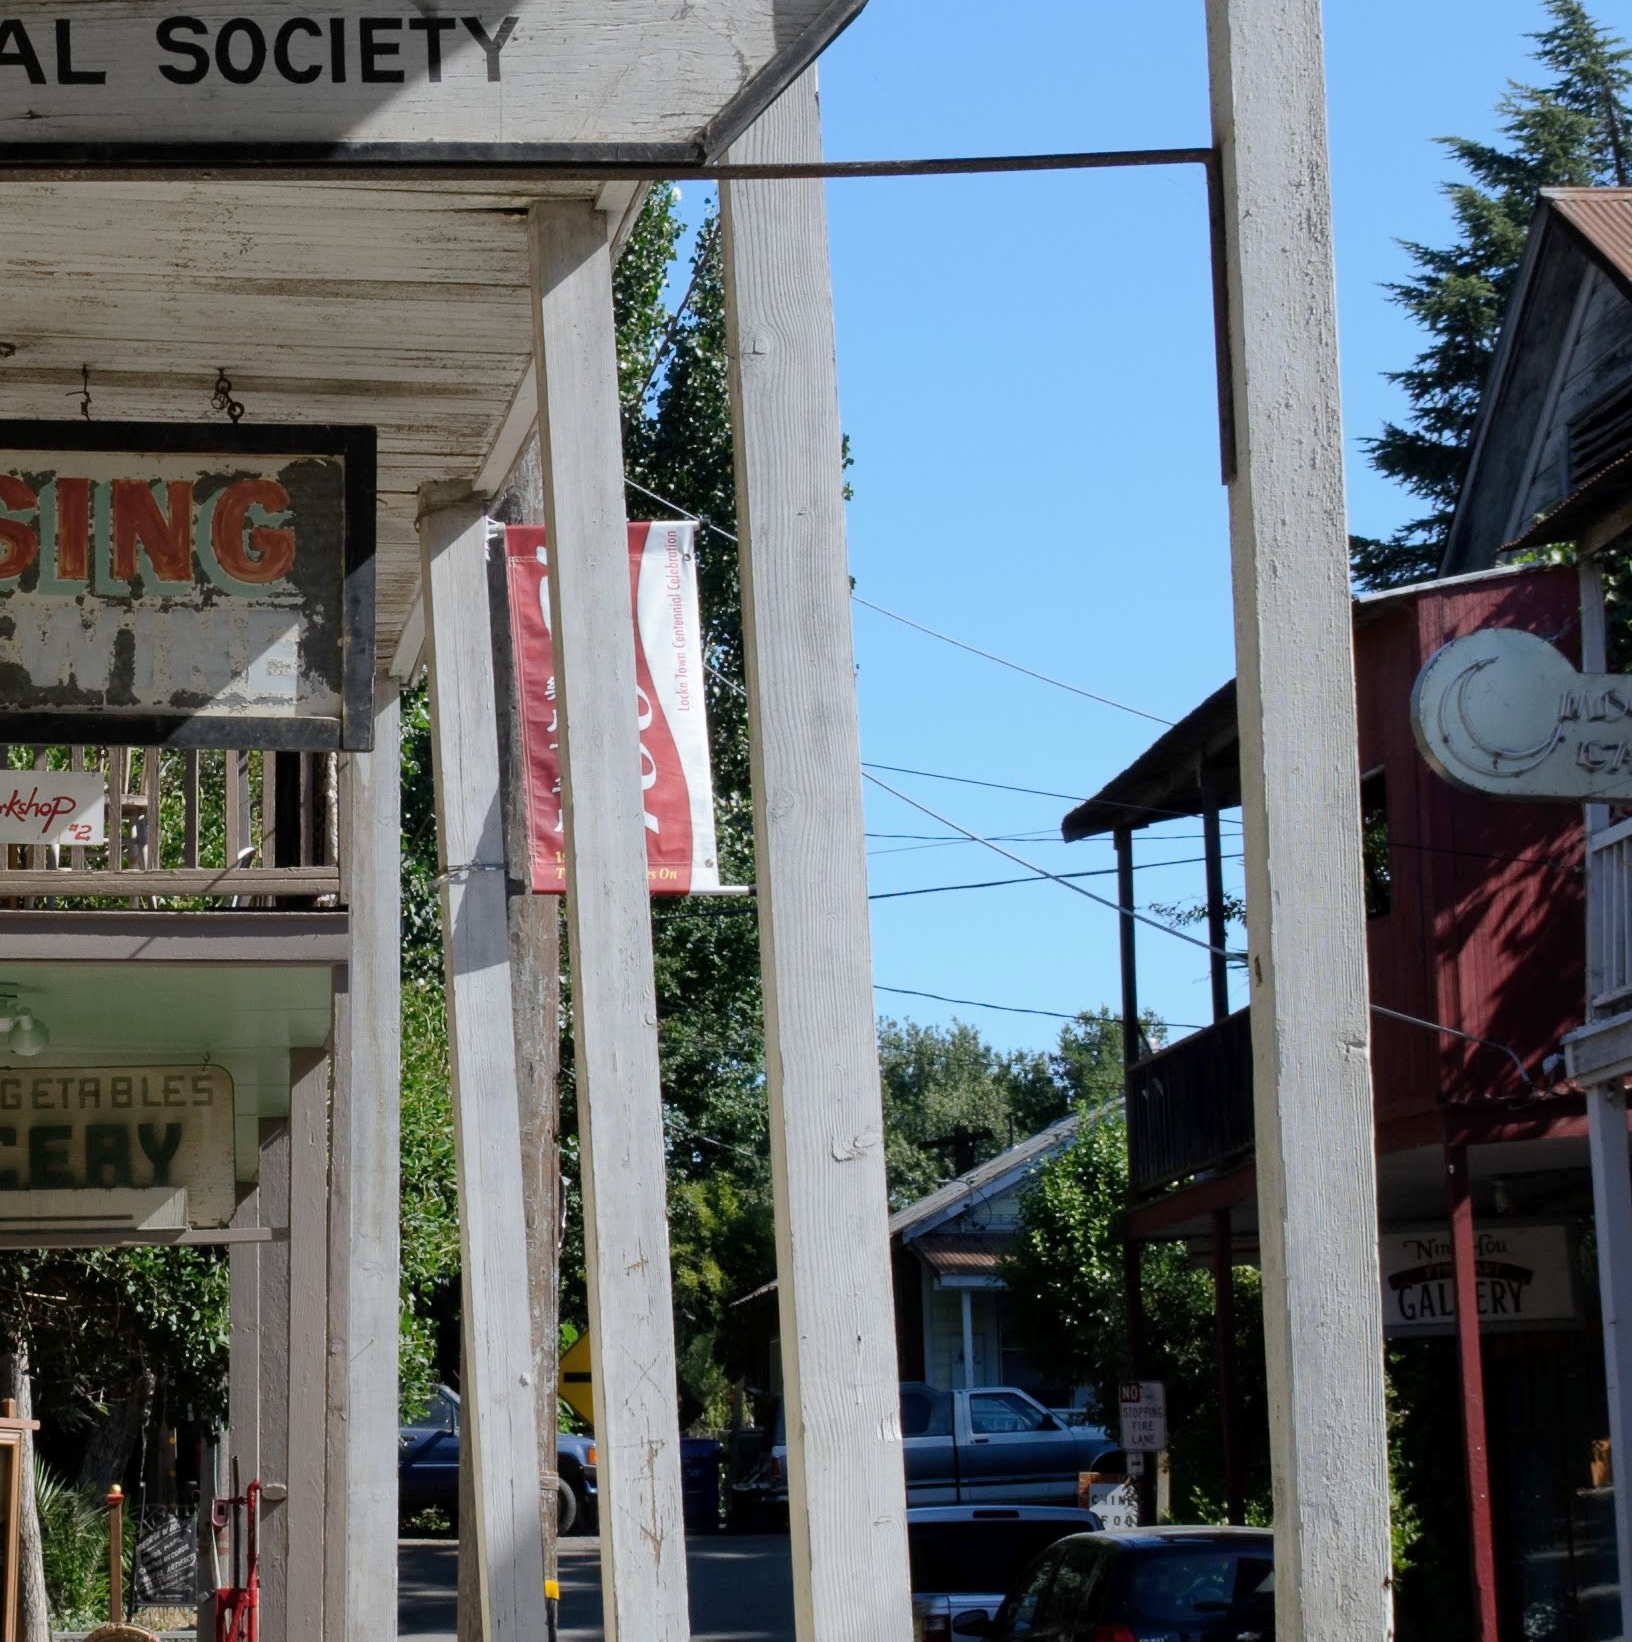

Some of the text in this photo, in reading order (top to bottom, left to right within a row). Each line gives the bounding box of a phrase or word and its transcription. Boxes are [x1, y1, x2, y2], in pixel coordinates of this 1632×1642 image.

[157, 13, 520, 87] SOCIETY
[664, 530, 690, 712] Locke Town Centennial Celebration
[658, 867, 678, 881] On
[1398, 1279, 1525, 1321] GALERY
[1122, 1385, 1139, 1401] NO
[1123, 1406, 1163, 1419] STOPPING
[1132, 1421, 1155, 1432] FIRE
[1131, 1434, 1156, 1445] LANE
